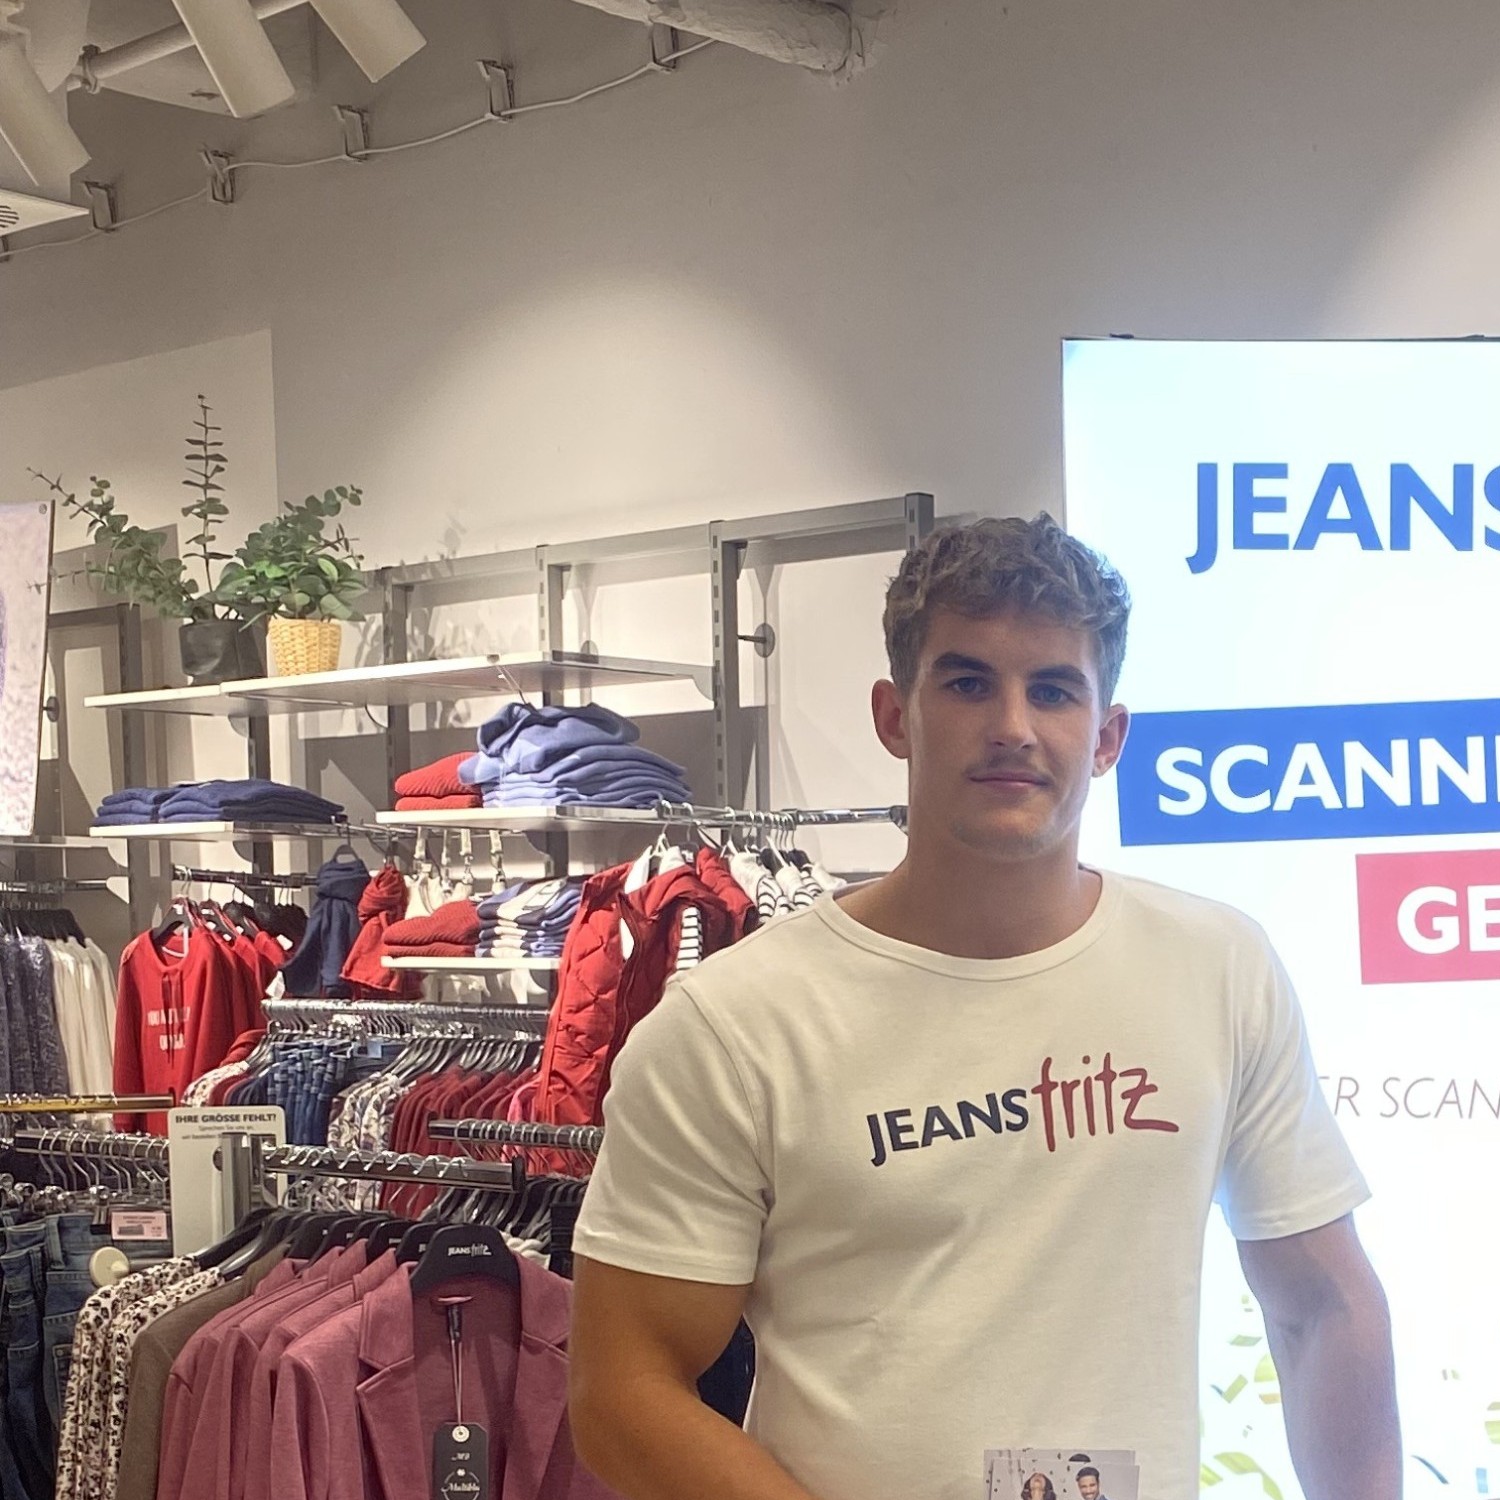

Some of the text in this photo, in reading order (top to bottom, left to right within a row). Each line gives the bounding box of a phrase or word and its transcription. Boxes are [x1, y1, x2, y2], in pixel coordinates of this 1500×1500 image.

[175, 1113, 277, 1124] IHRE GRÖSSE FEHLT?
